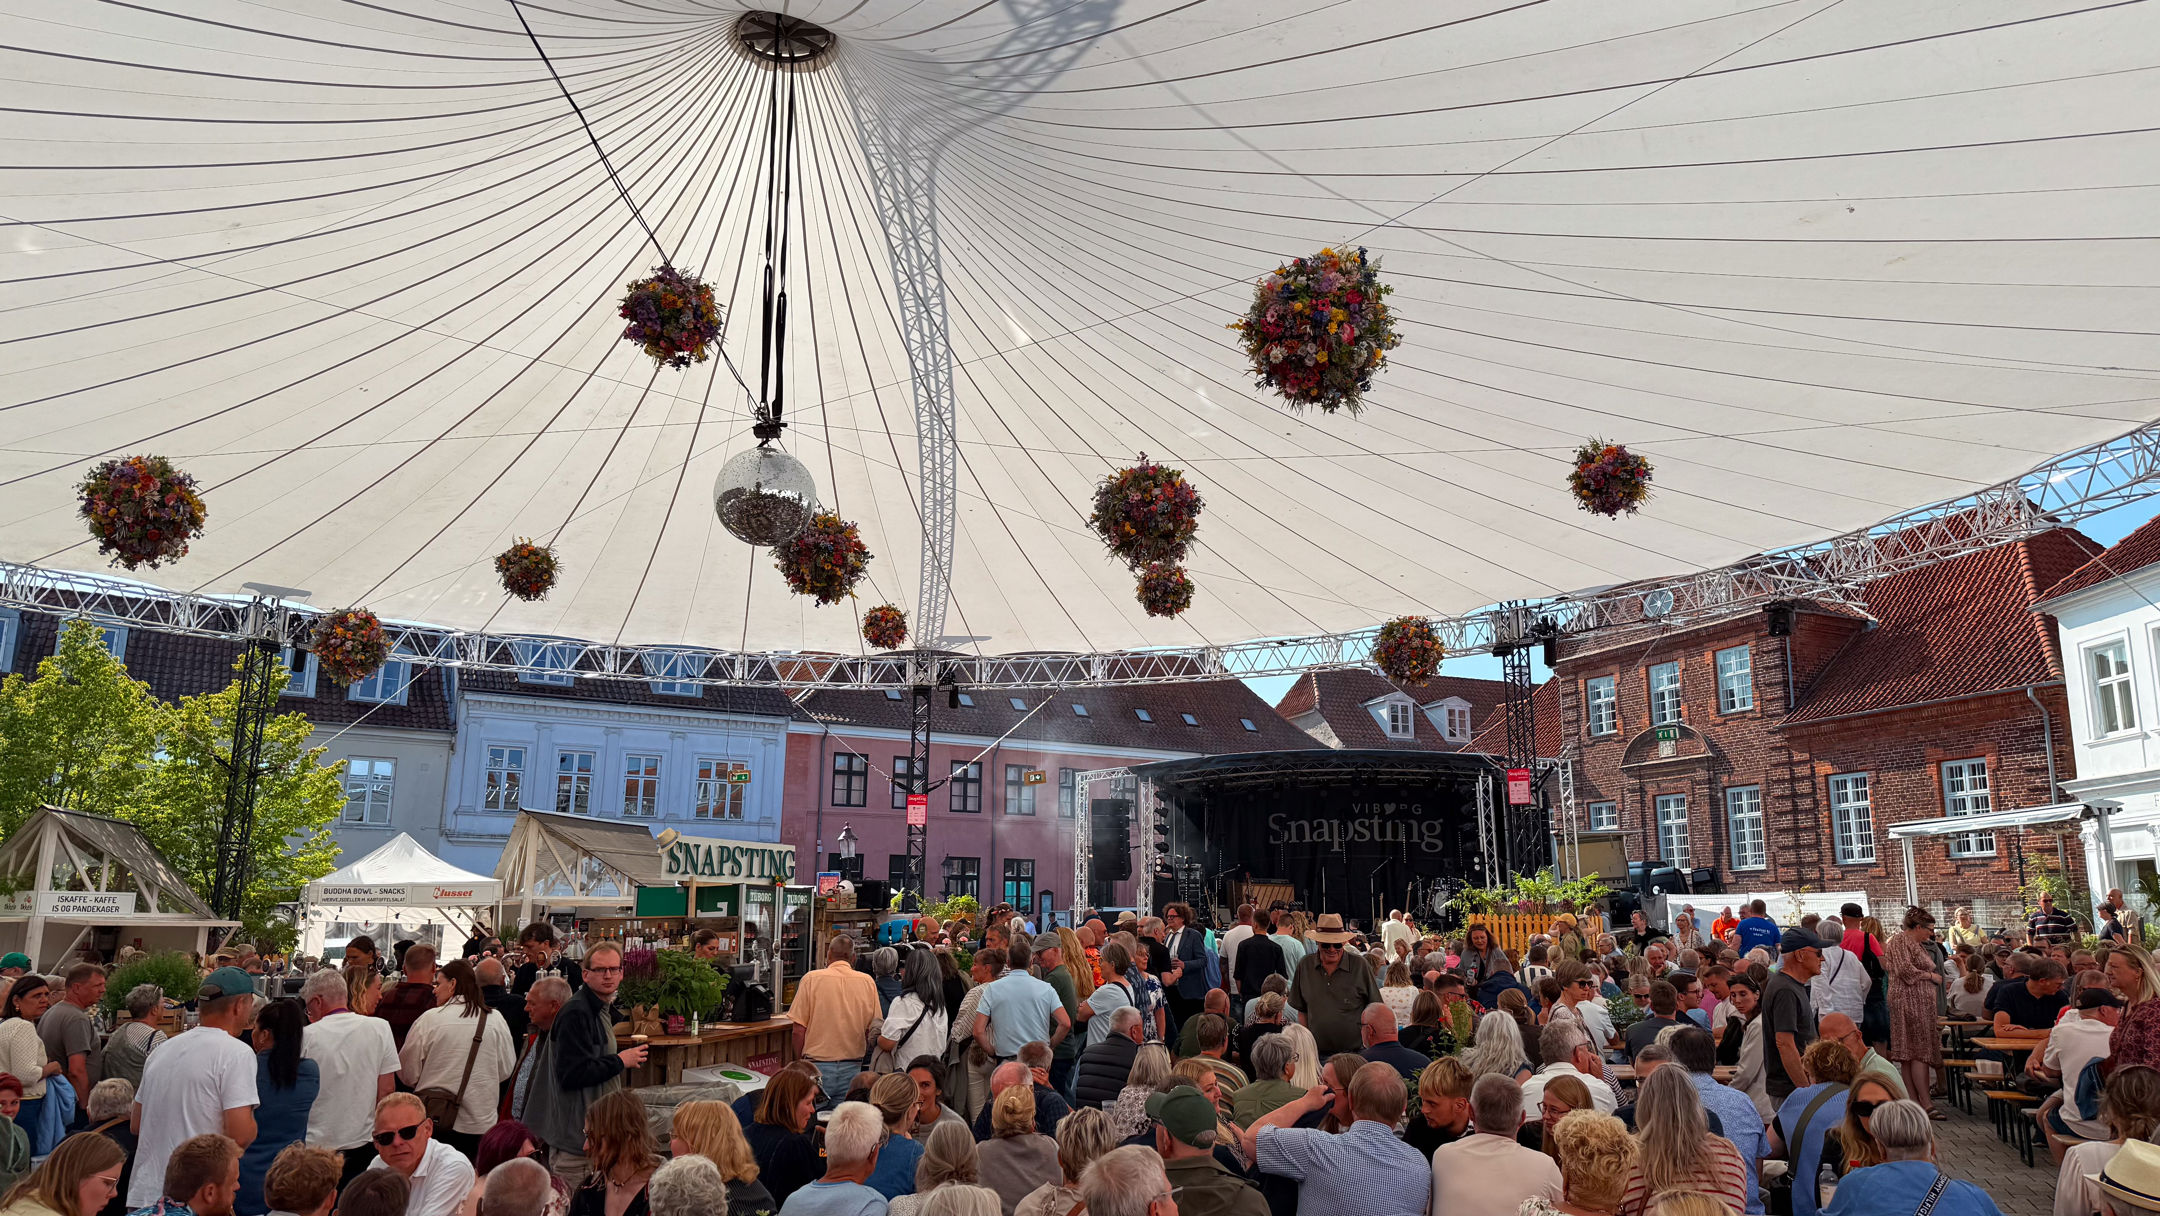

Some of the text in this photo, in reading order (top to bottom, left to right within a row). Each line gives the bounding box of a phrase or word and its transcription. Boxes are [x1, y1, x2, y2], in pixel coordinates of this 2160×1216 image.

[1267, 812, 1444, 853] Snapsting
[668, 840, 795, 880] SNAPSTING
[323, 887, 352, 895] BUDDHA
[353, 887, 373, 895] BOWL
[379, 887, 406, 895] SNACKS
[57, 895, 88, 904] ISKAFFE
[94, 896, 118, 904] KAFFE
[749, 892, 772, 902] TUBORG
[787, 894, 808, 904] TUBORG
[52, 904, 120, 913] IS OG PANDEKAGER
